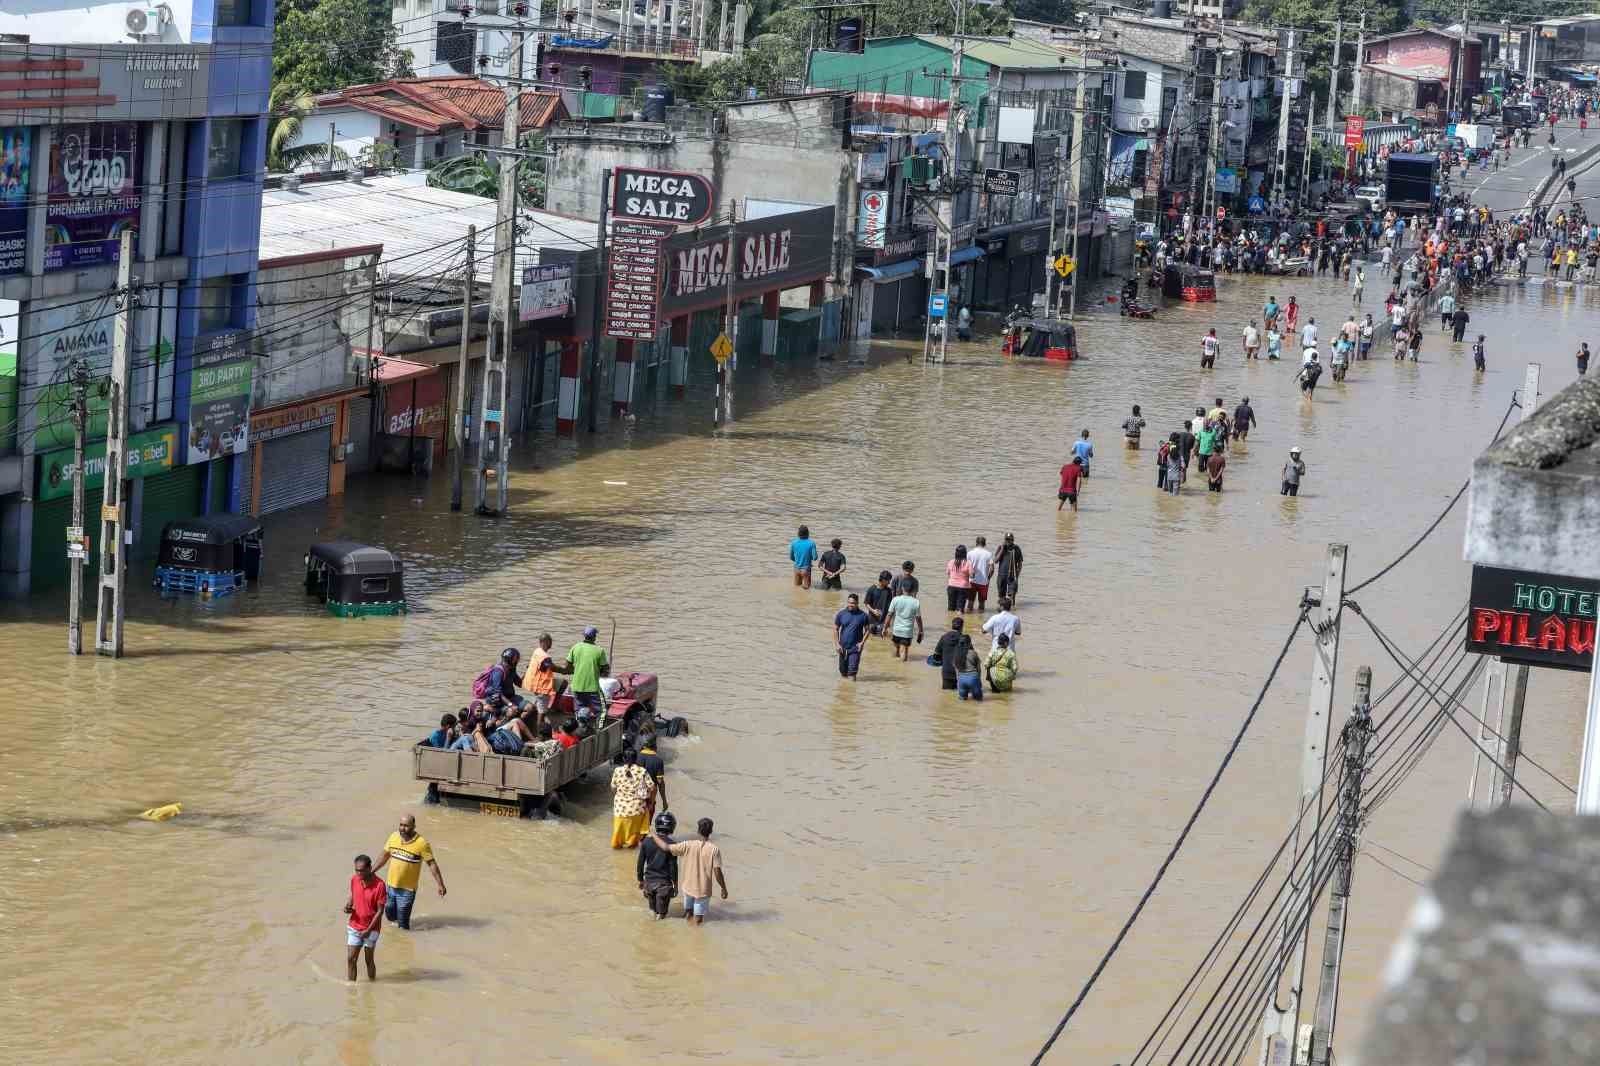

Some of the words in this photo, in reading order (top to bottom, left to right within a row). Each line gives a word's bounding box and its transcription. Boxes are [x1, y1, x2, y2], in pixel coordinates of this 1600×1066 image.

[625, 174, 696, 197] MEGA
[626, 198, 690, 220] SALE
[743, 228, 791, 279] SALE
[54, 330, 108, 353] AMANA
